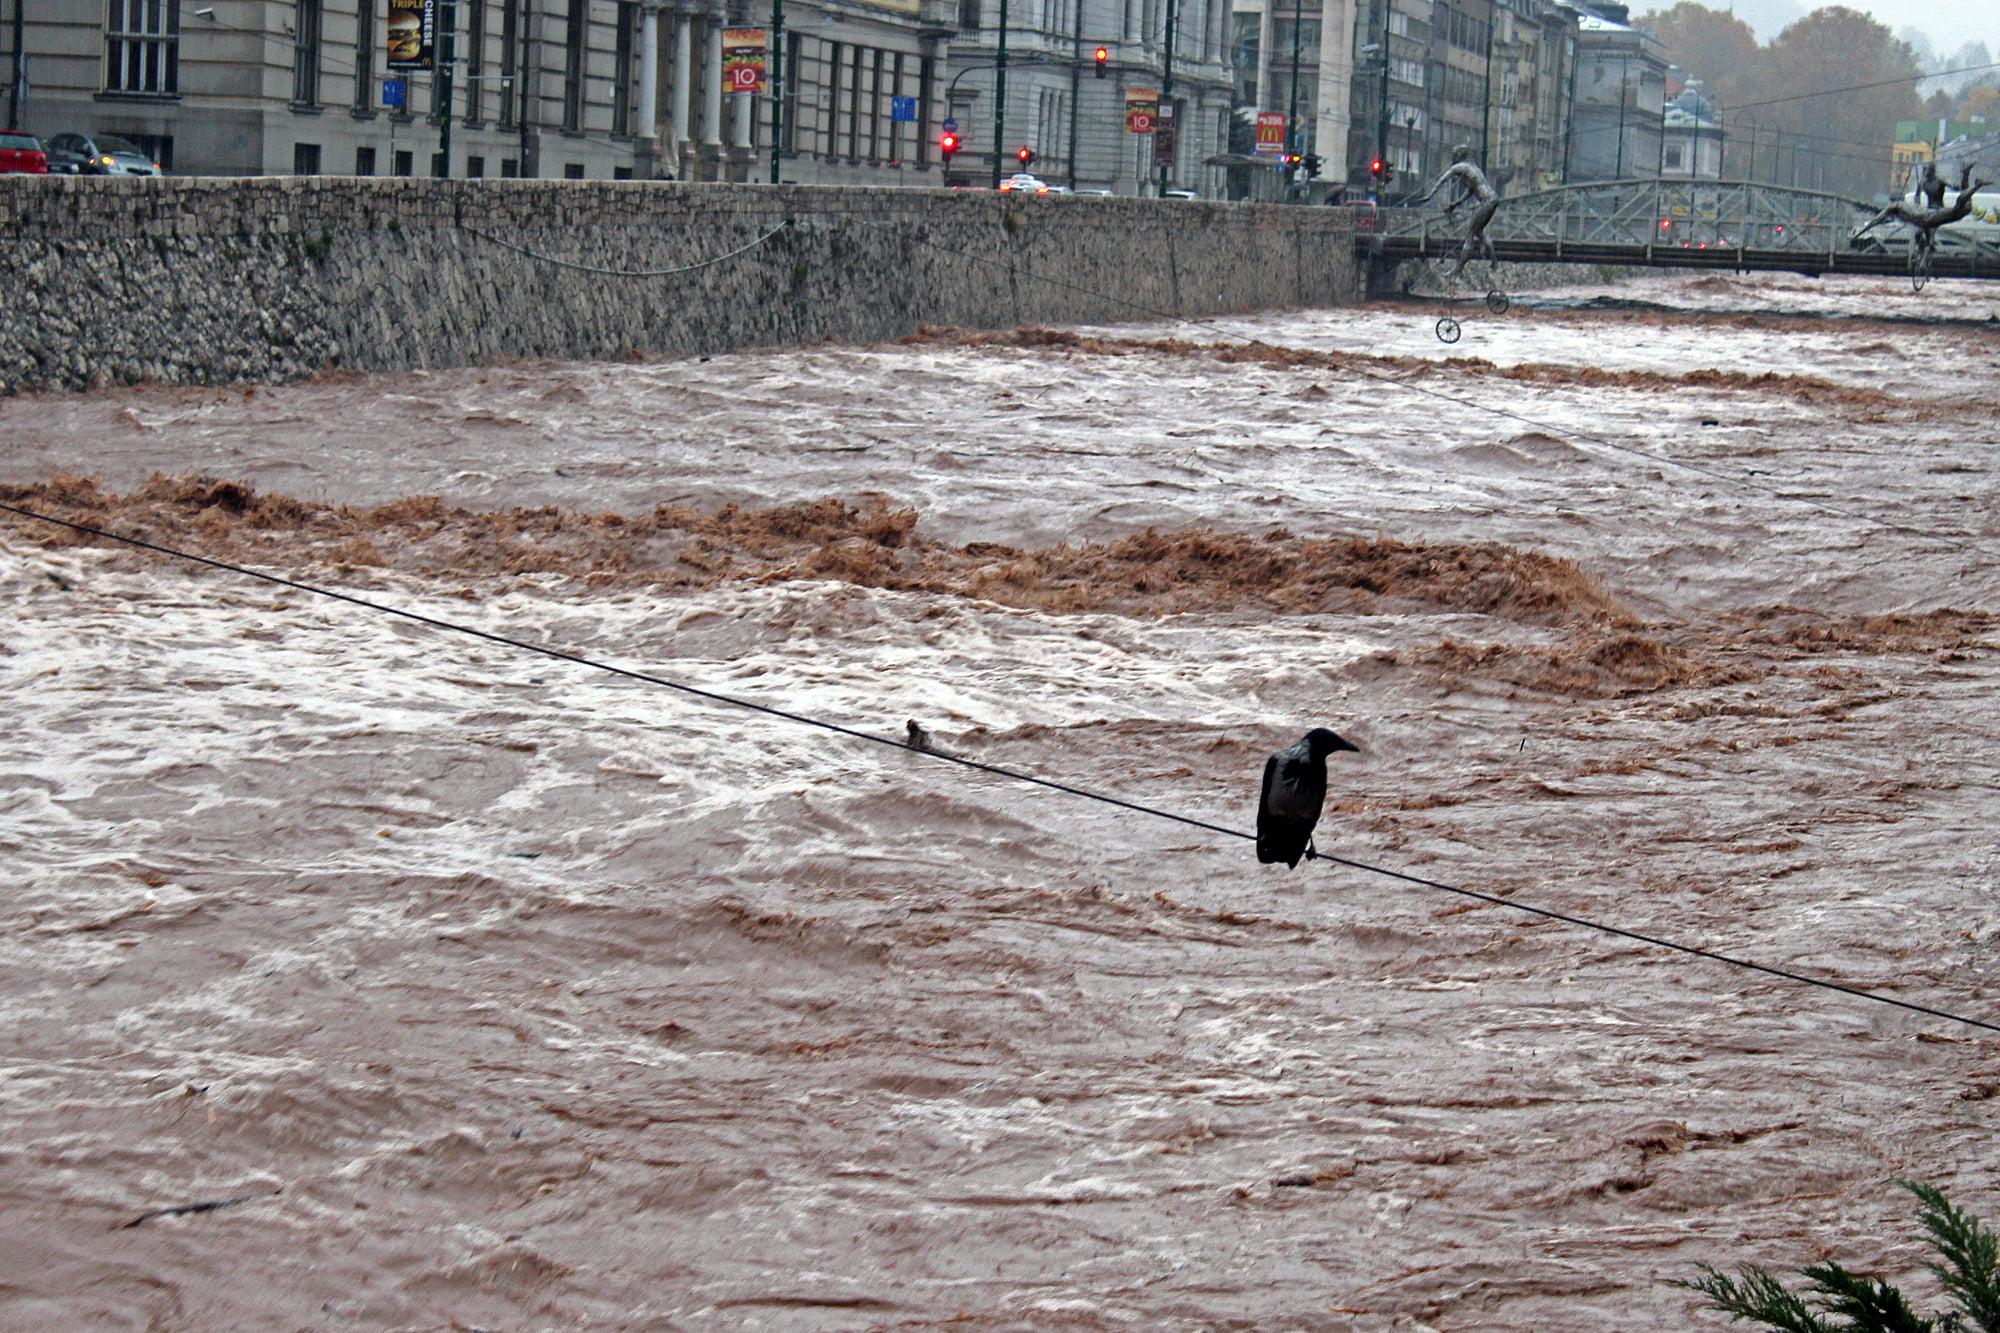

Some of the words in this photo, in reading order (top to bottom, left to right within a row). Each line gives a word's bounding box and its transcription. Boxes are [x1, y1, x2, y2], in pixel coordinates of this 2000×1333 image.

[392, 0, 424, 8] TRIPLE
[424, 0, 433, 46] CHEESE
[734, 68, 755, 84] 10
[1133, 115, 1149, 129] 10
